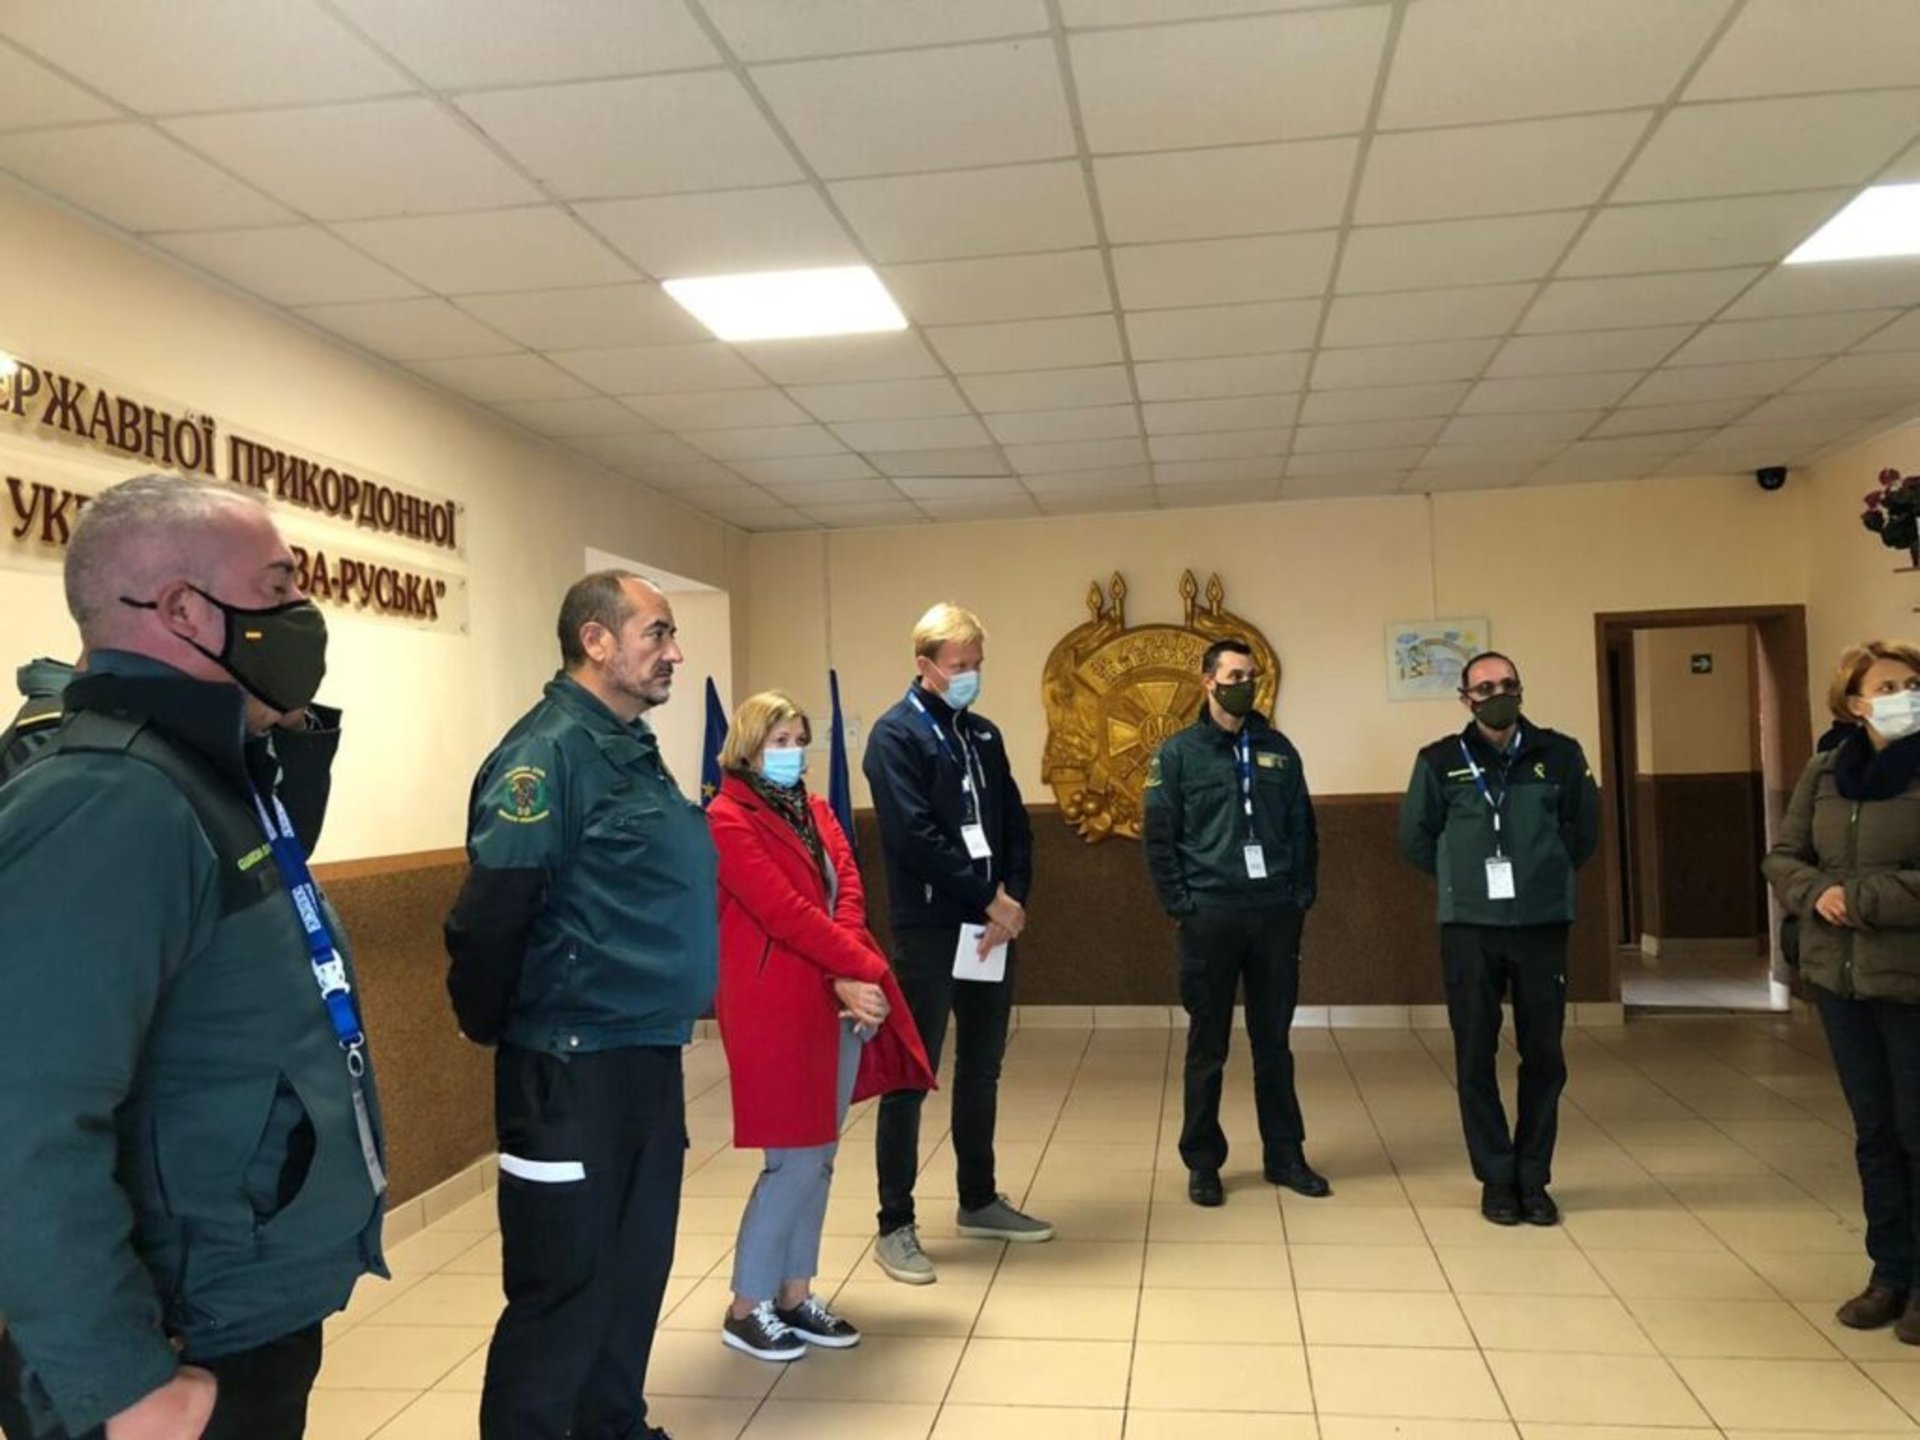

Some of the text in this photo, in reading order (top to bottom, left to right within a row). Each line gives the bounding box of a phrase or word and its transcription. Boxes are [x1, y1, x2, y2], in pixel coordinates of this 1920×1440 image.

[6, 477, 446, 619] УК ВА-РУСЬКА”
[229, 435, 457, 548] ПРИКОРДОННОЇ
